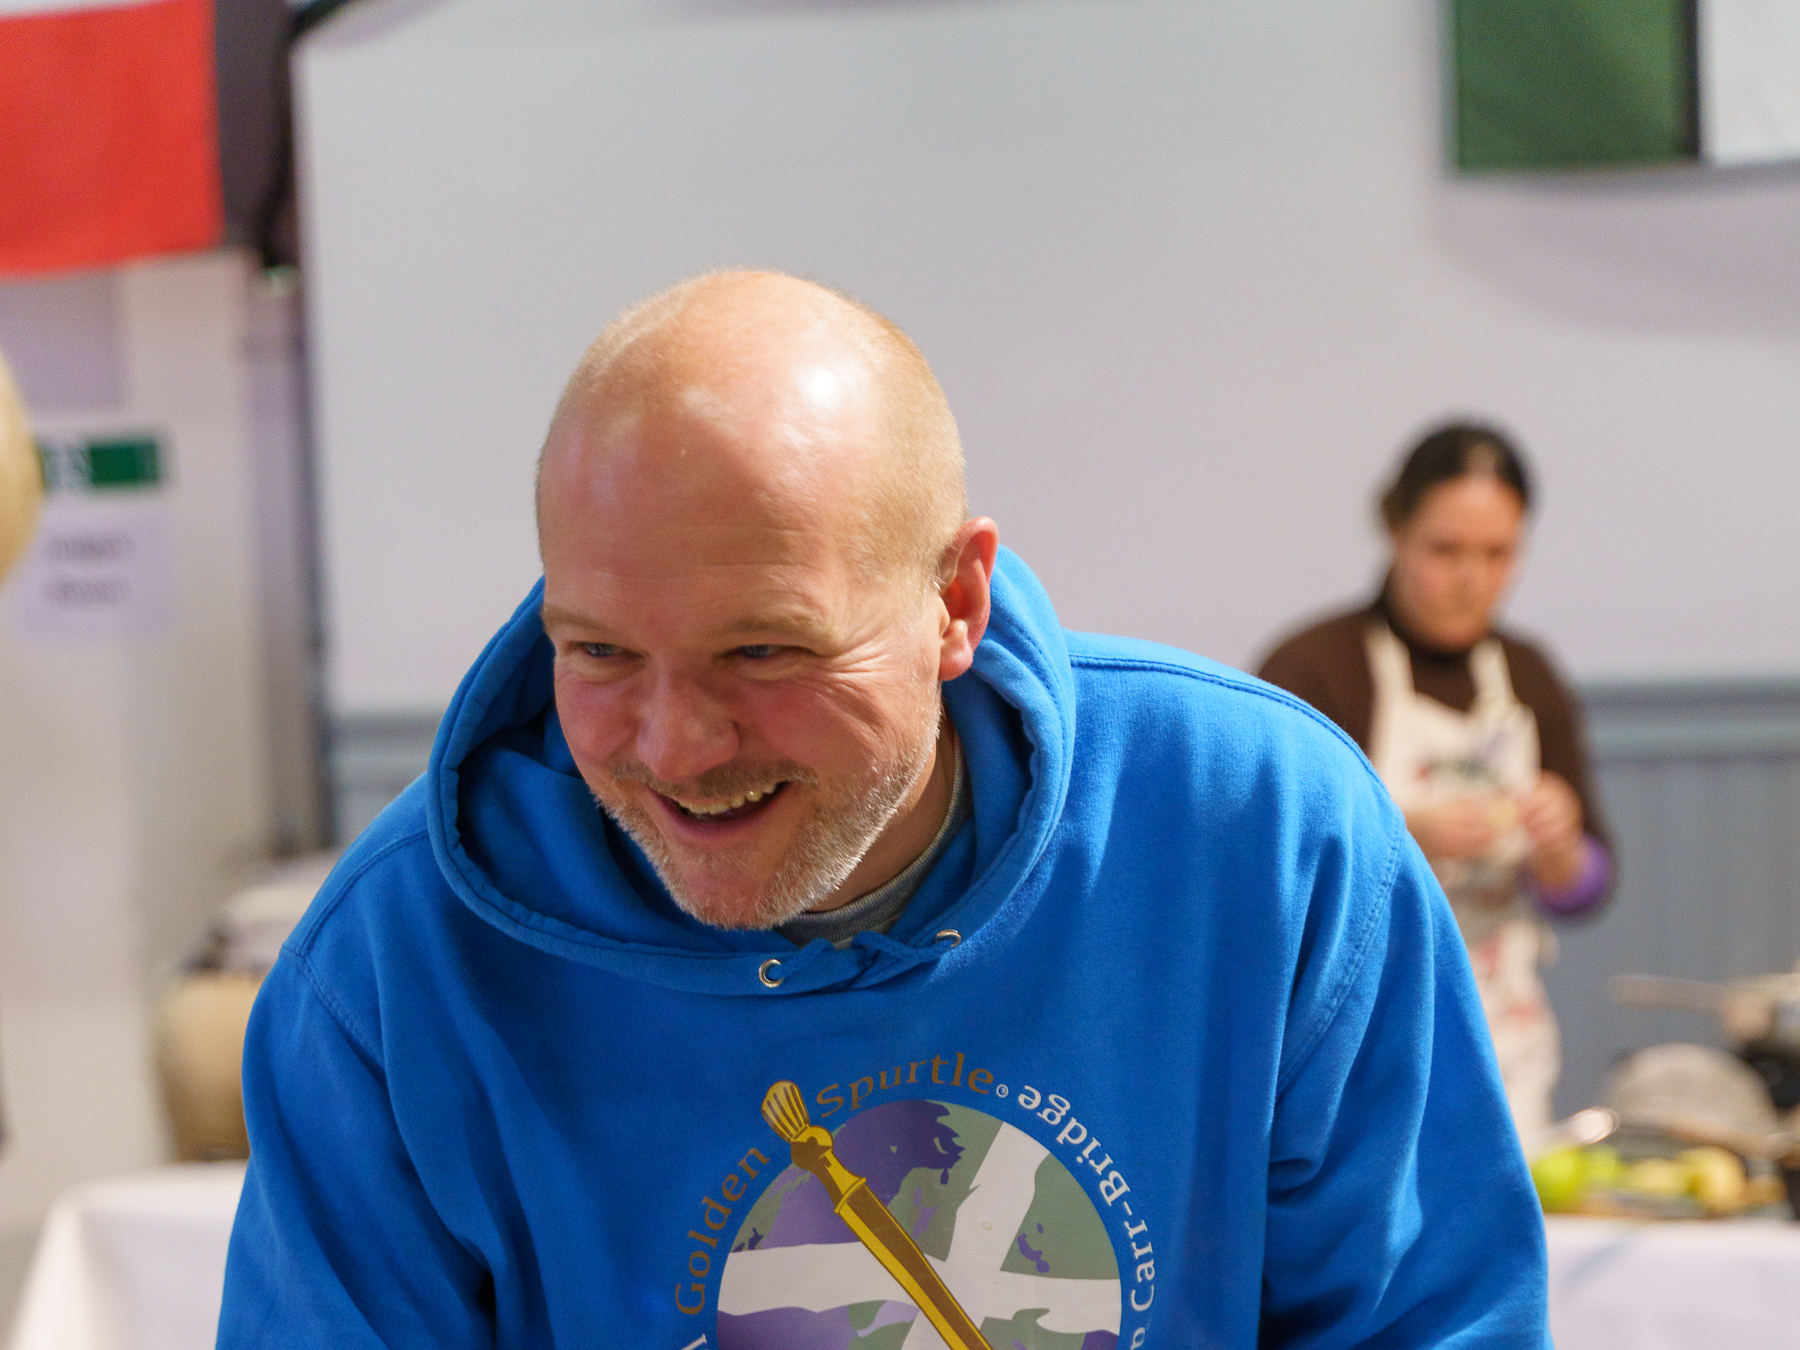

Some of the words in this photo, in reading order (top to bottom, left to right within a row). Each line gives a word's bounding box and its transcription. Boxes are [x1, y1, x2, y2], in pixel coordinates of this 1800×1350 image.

[675, 1146, 771, 1316] Golden
[816, 1051, 994, 1119] Spurtle
[1017, 1084, 1156, 1312] Carr-Bridge
